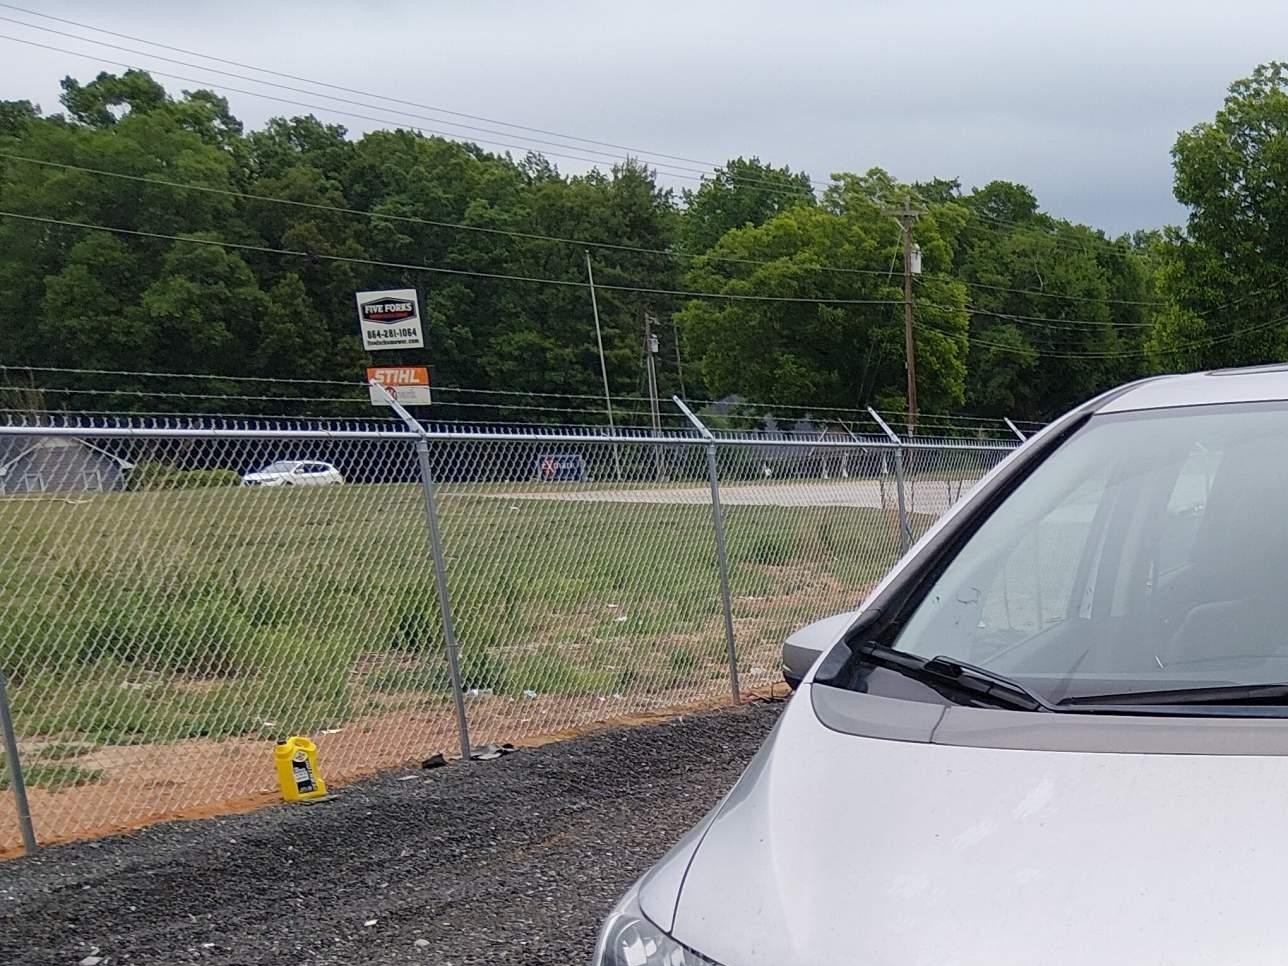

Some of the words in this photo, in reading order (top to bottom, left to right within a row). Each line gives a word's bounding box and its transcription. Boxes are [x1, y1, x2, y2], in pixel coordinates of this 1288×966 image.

[365, 303, 383, 314] FIVE
[384, 302, 412, 313] FORKS
[375, 369, 420, 383] STIHL
